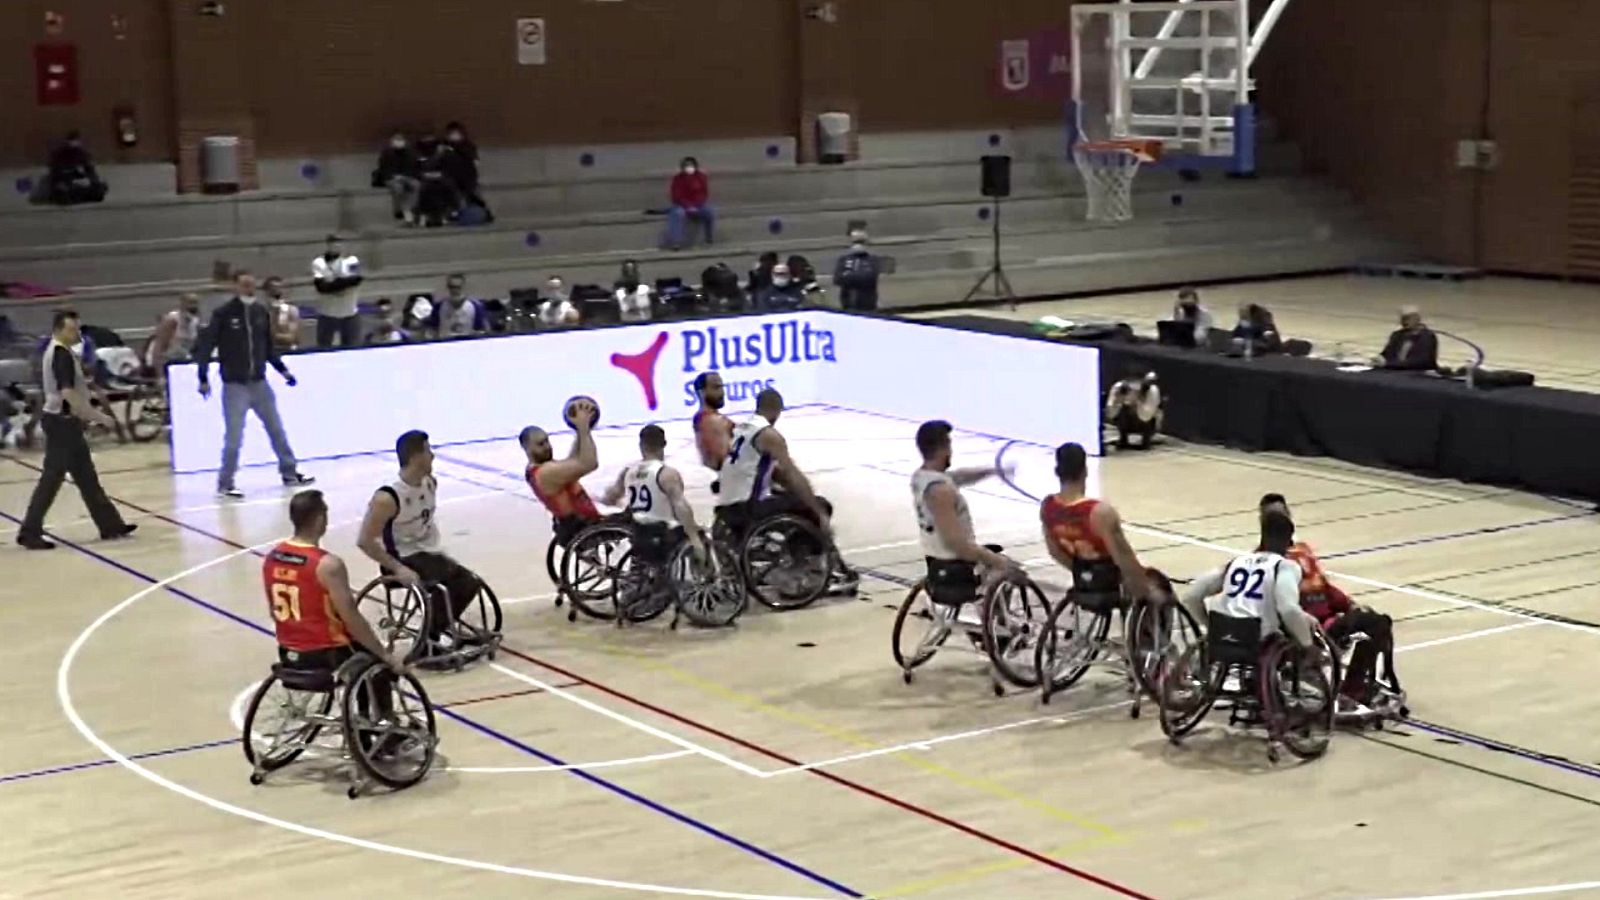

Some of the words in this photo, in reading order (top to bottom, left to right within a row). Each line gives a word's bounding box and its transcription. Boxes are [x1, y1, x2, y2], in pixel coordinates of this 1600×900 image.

[681, 320, 836, 372] PlusUltra
[272, 583, 301, 622] 51
[1227, 567, 1265, 600] 92
